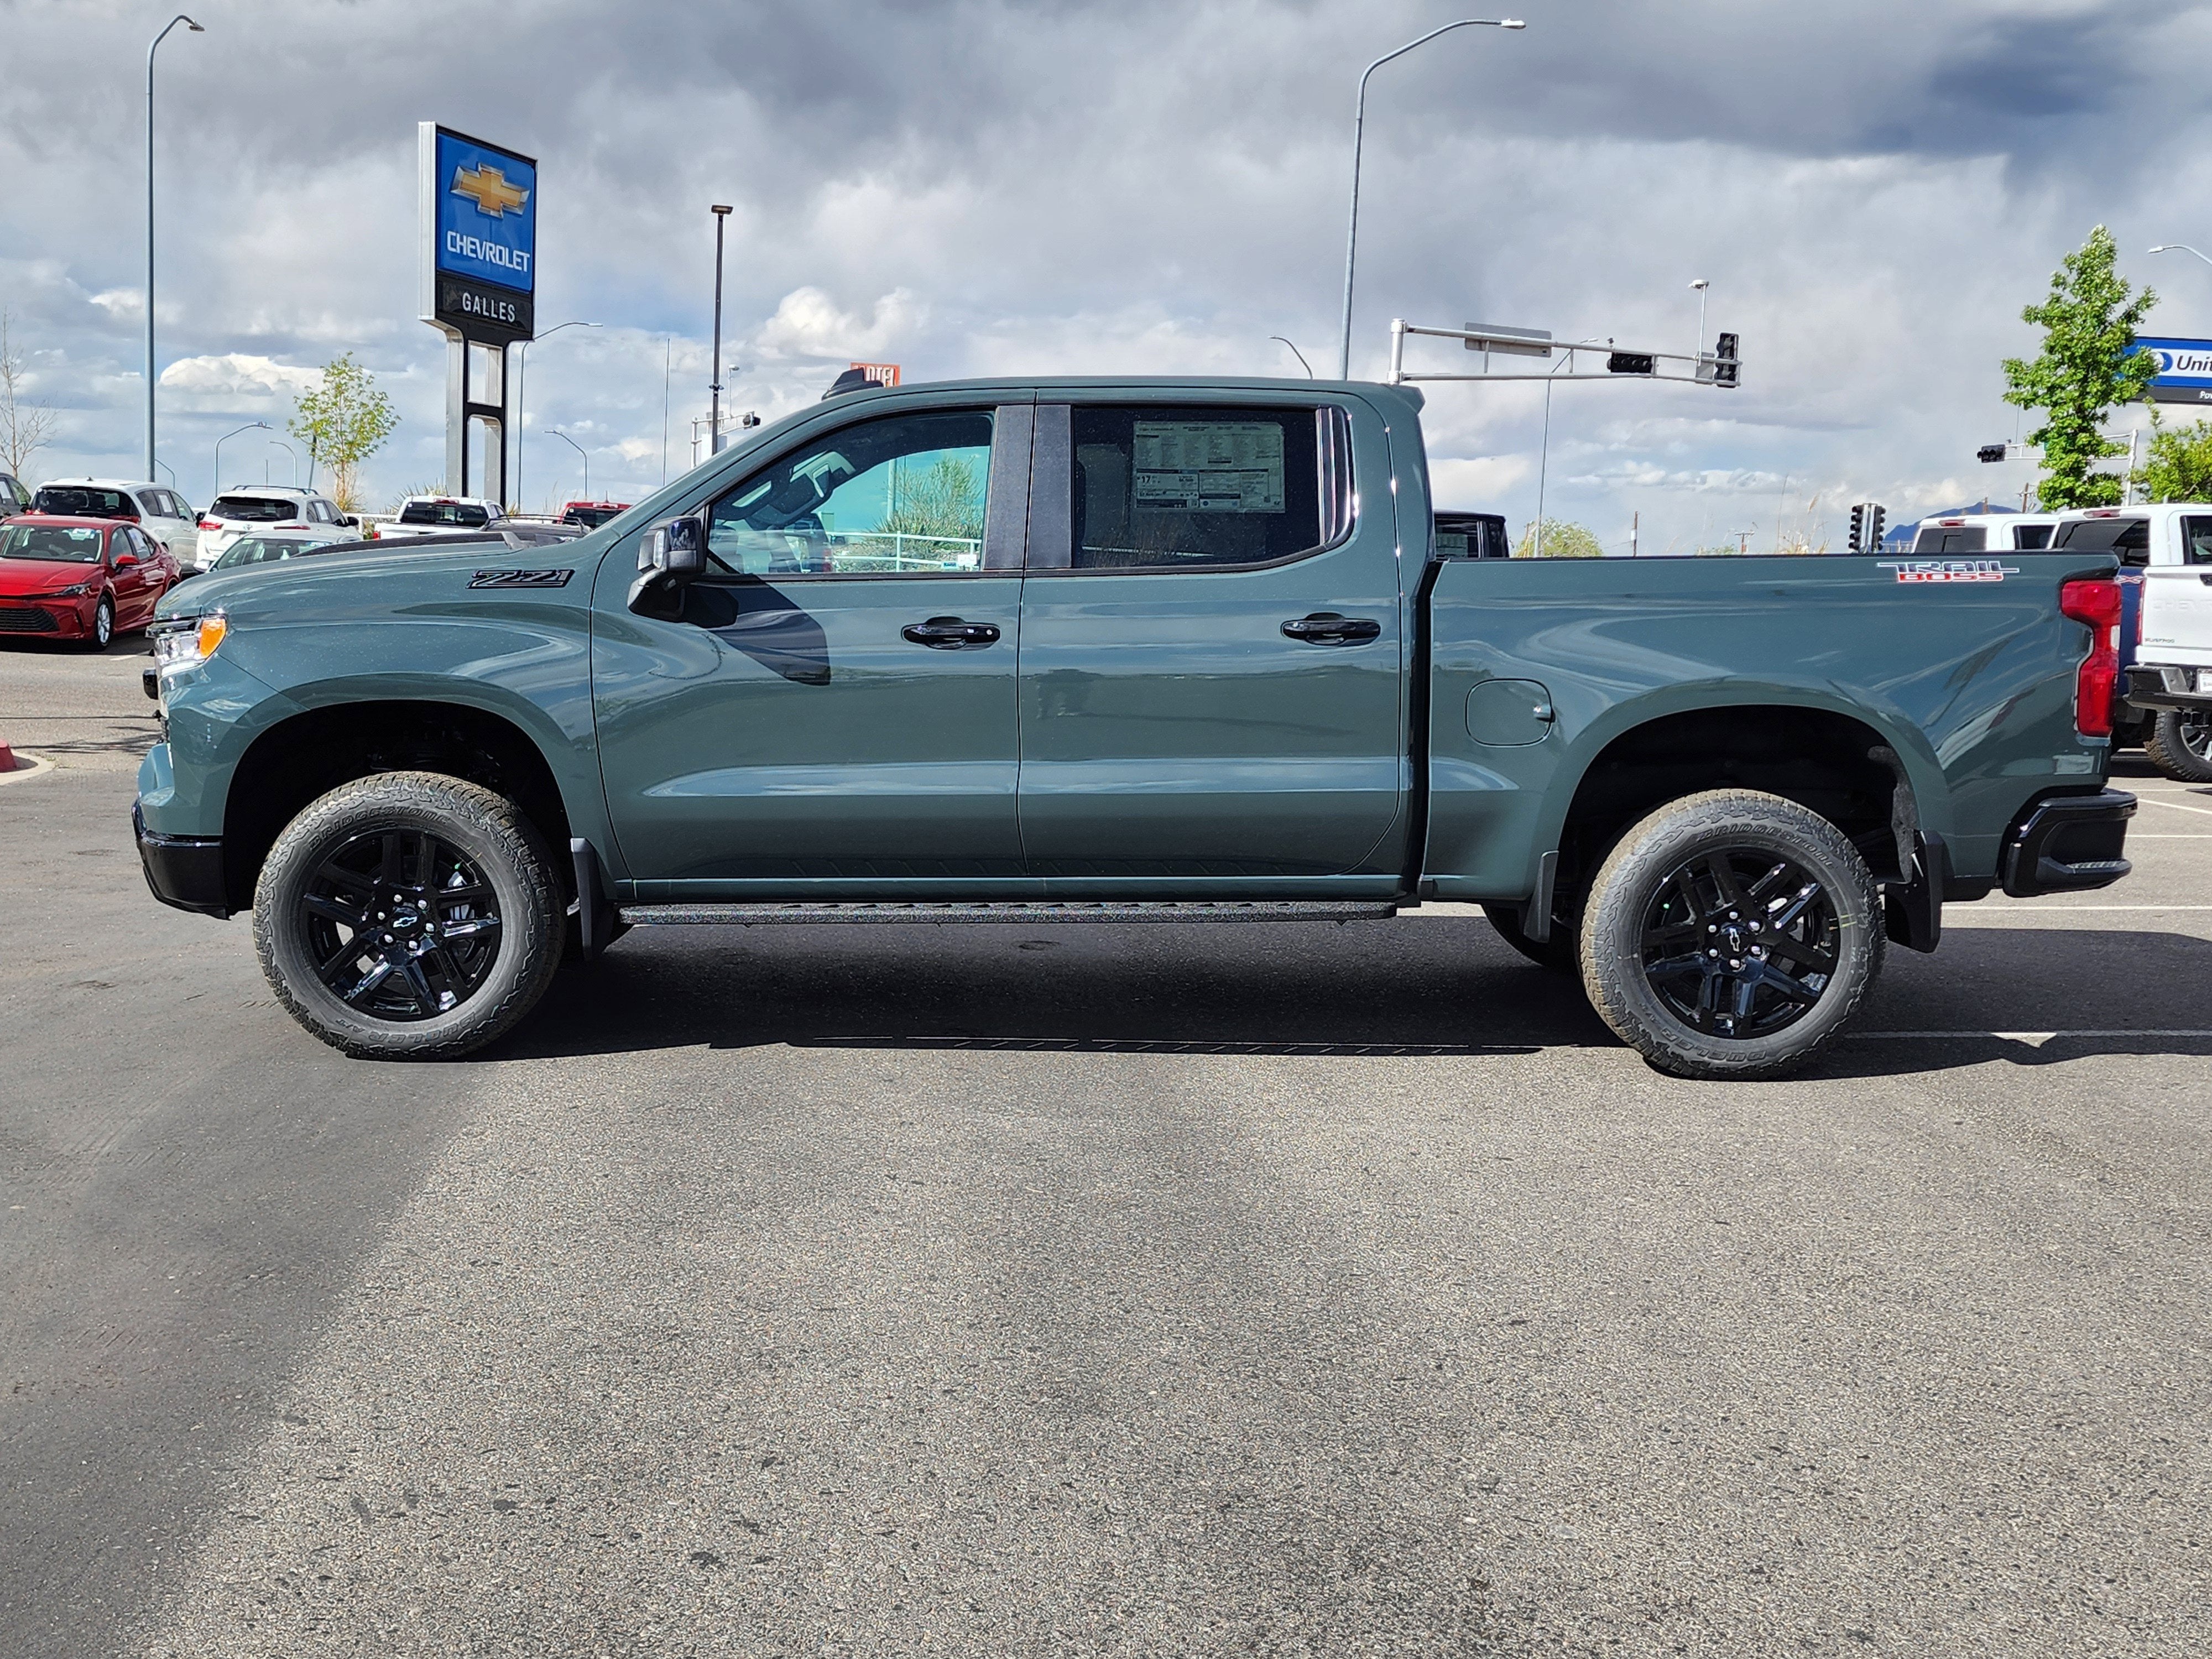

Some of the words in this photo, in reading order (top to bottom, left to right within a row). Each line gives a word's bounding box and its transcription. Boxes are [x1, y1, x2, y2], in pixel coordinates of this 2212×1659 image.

[447, 231, 530, 273] CHEVROLET
[462, 292, 515, 322] GALLES
[465, 569, 575, 589] Z71
[1876, 561, 2020, 573] TRAIL
[1898, 572, 2004, 583] BOSS
[308, 806, 451, 851] BRIDGESTONE
[1697, 822, 1839, 870] BRIDGESTONE
